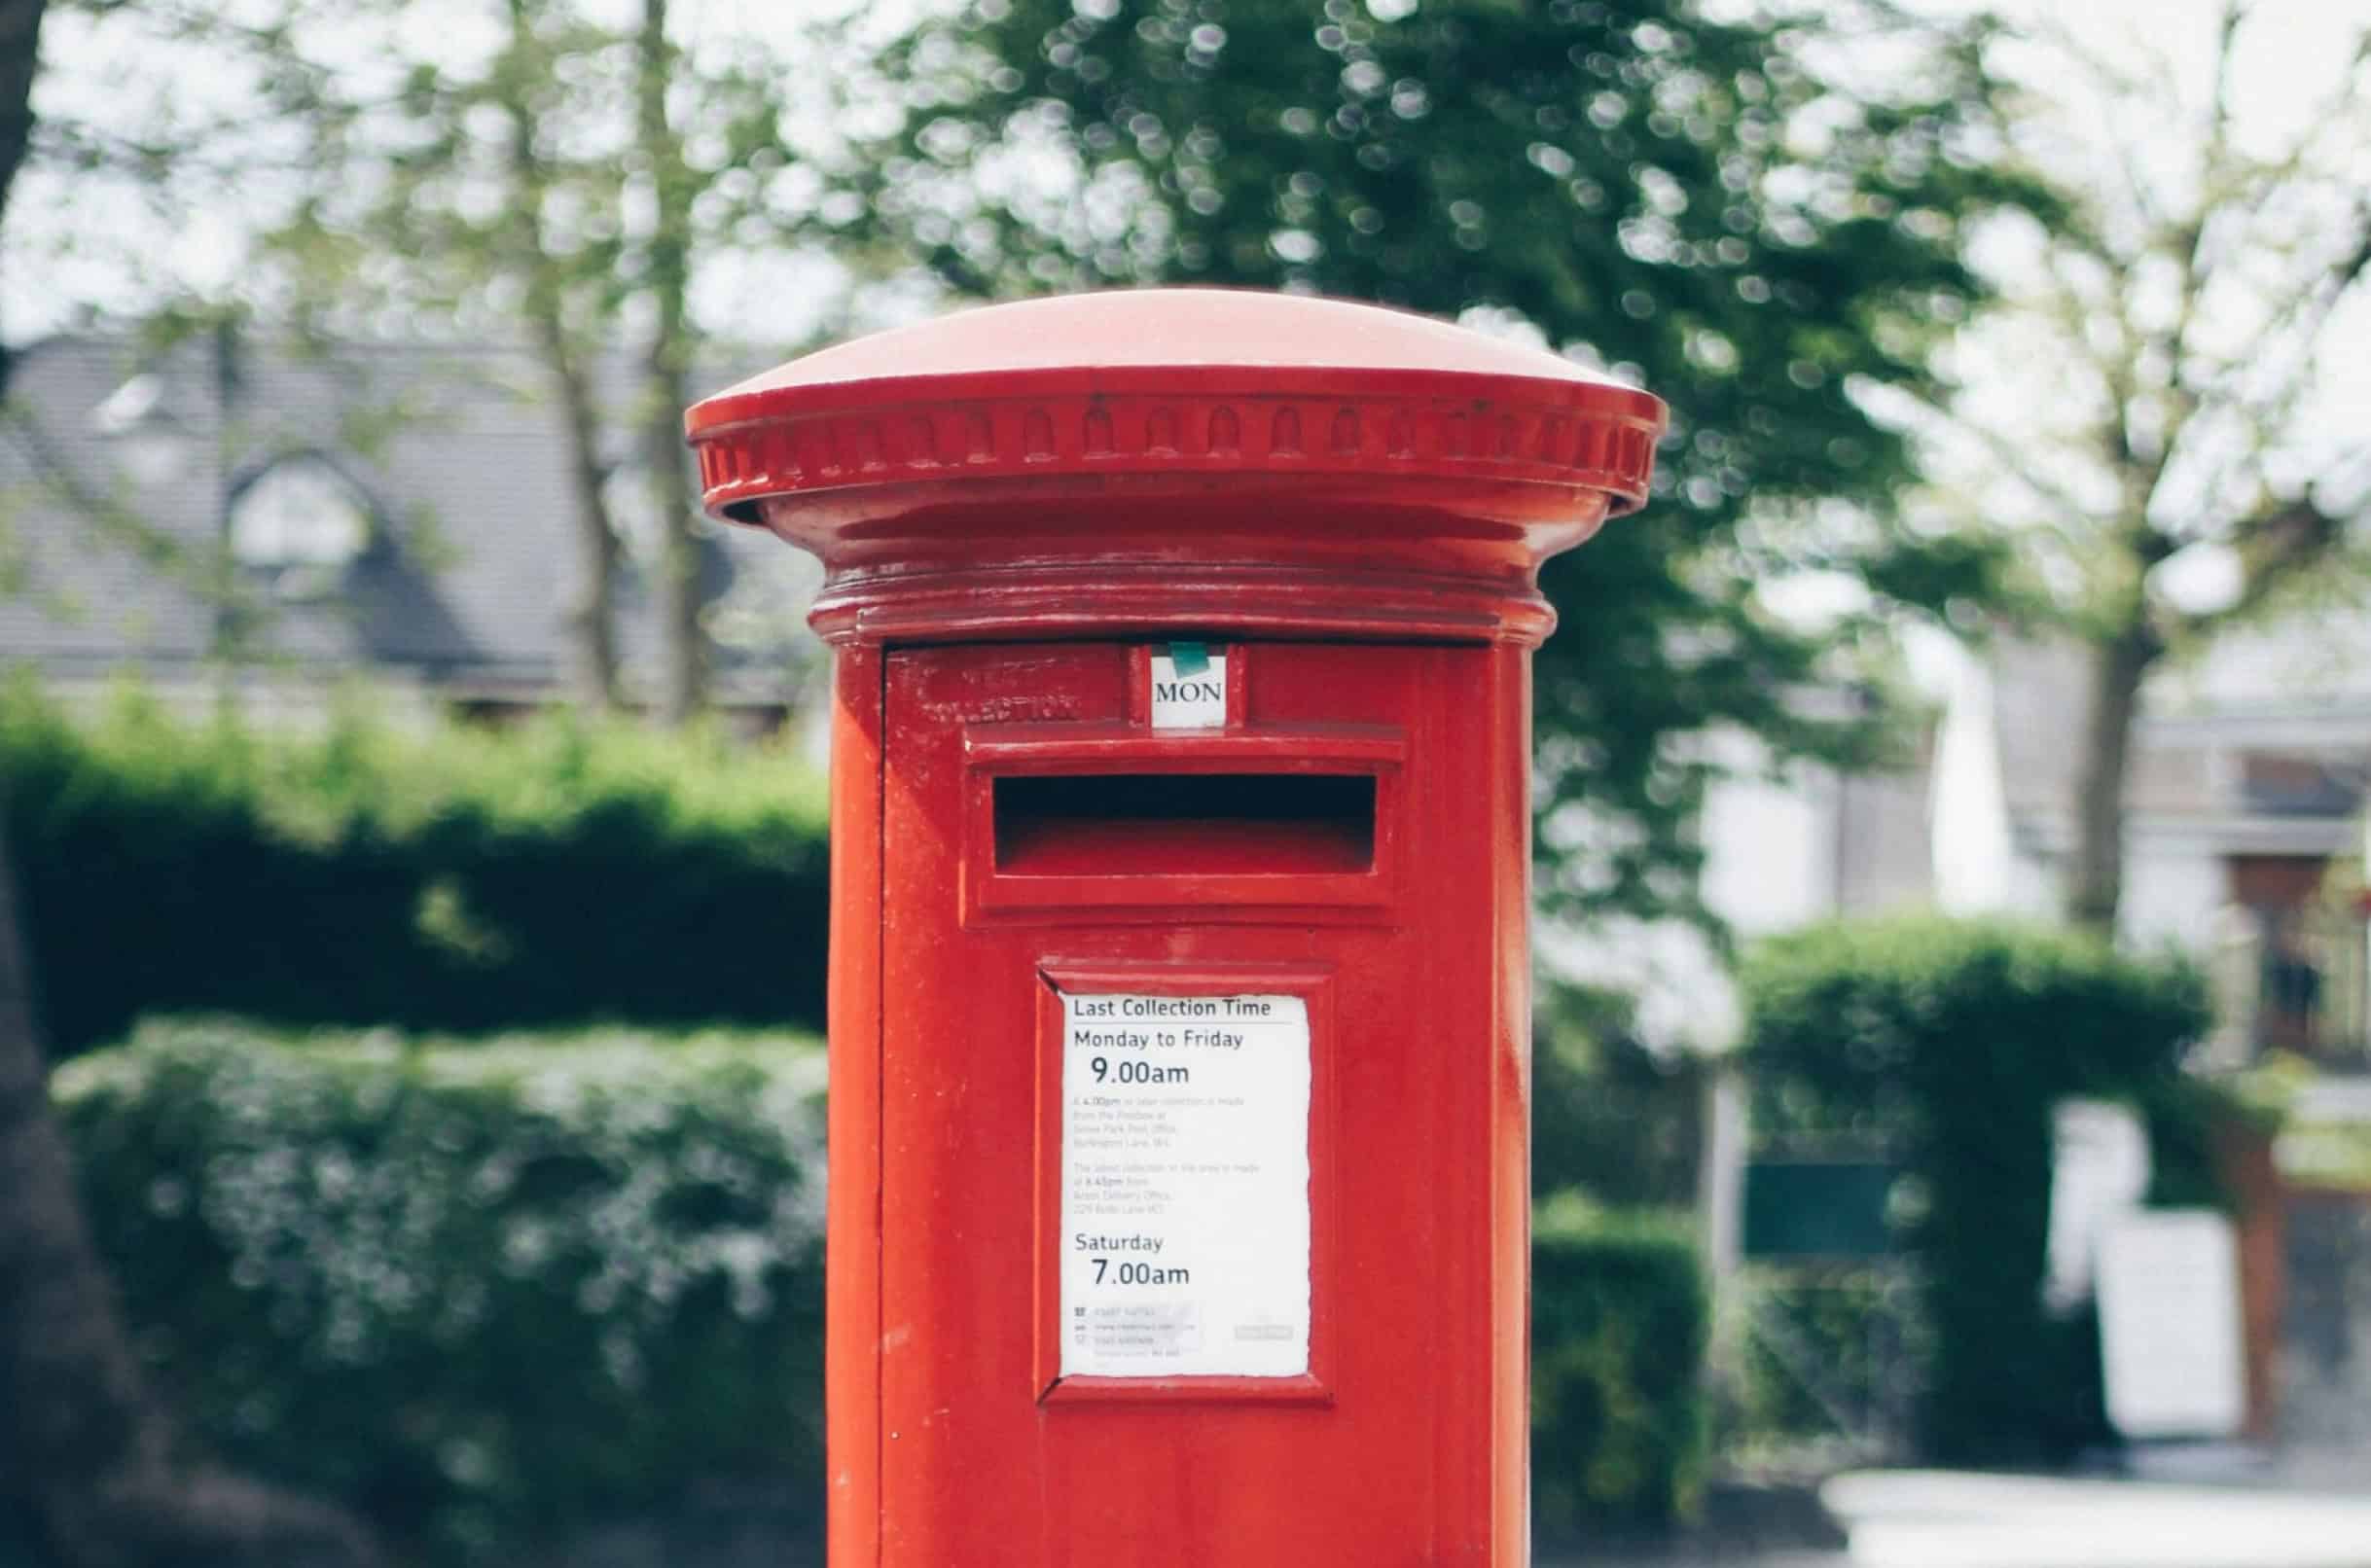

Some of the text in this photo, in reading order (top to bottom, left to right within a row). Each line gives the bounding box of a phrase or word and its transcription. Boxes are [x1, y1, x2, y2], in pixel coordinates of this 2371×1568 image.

[1155, 681, 1223, 703] MON
[1074, 997, 1272, 1016] Last Collection Time
[1074, 1029, 1243, 1051] Monday to Friday
[1091, 1056, 1189, 1084] 9.00am
[1075, 1233, 1162, 1254] Saturday
[1091, 1258, 1190, 1285] 7.00am
